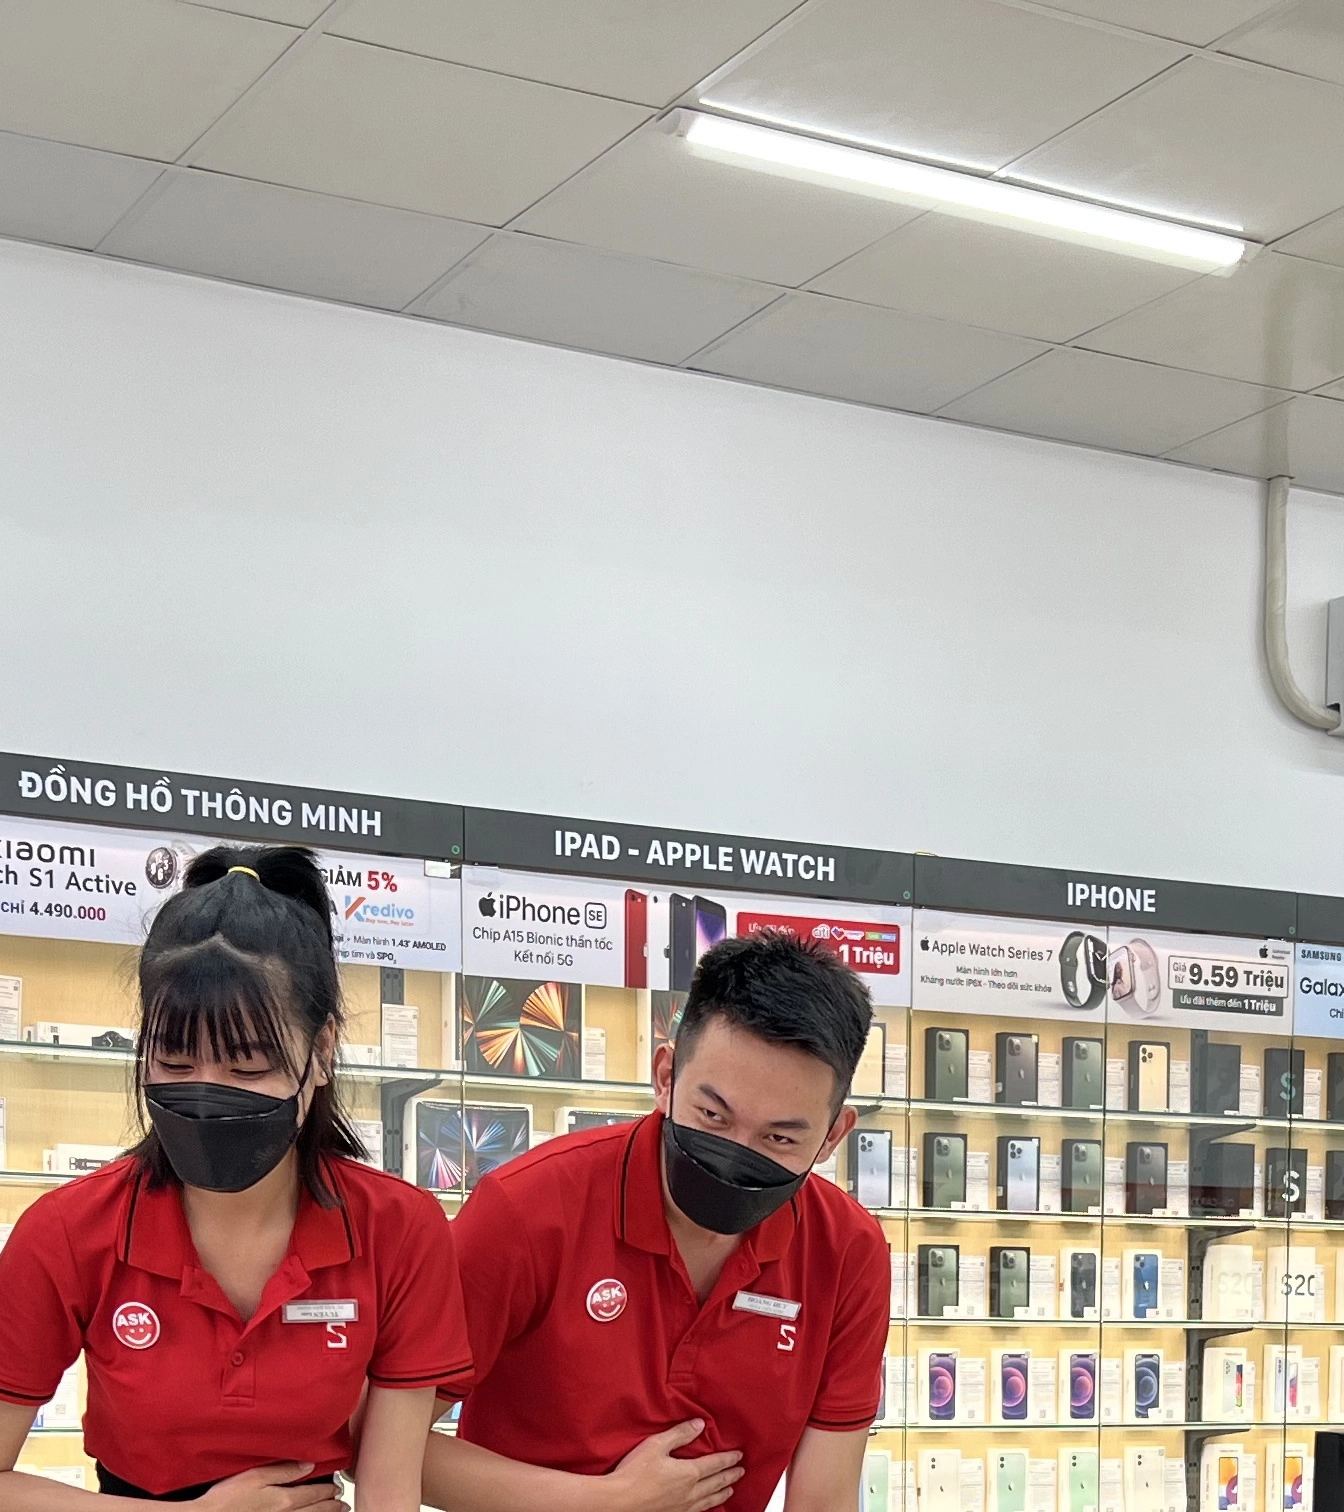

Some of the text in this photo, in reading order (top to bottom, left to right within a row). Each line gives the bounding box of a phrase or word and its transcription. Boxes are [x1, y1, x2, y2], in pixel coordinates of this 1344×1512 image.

[18, 763, 382, 837] ĐỒNG HỒ THÔNG MINH
[554, 829, 621, 862] IPAD
[646, 839, 734, 873] APPLE
[739, 848, 836, 883] WATCH
[29, 867, 55, 889] S1
[65, 871, 137, 897] Active
[366, 870, 398, 893] 5%
[344, 895, 415, 923] Kredivo
[1067, 881, 1156, 913] IPHONE
[1, 898, 25, 915] CHỈ
[29, 901, 107, 922] 4.490.000
[499, 893, 603, 926] iPhone SE
[412, 940, 447, 951] AMOLED
[472, 926, 501, 943] Chip
[502, 929, 524, 944] A15
[526, 931, 564, 947] Bionic
[594, 936, 613, 951] tốc
[932, 940, 1053, 961] Apple Watch Series 7
[514, 949, 574, 967] Kết nối 5G
[838, 944, 894, 969] 1 Triệu
[1301, 949, 1342, 962] SAMSUNG
[1189, 963, 1284, 992] 9.59 Triệu
[1249, 999, 1276, 1013] Triệu
[591, 1285, 623, 1305] ASK
[116, 1311, 152, 1327] ASK
